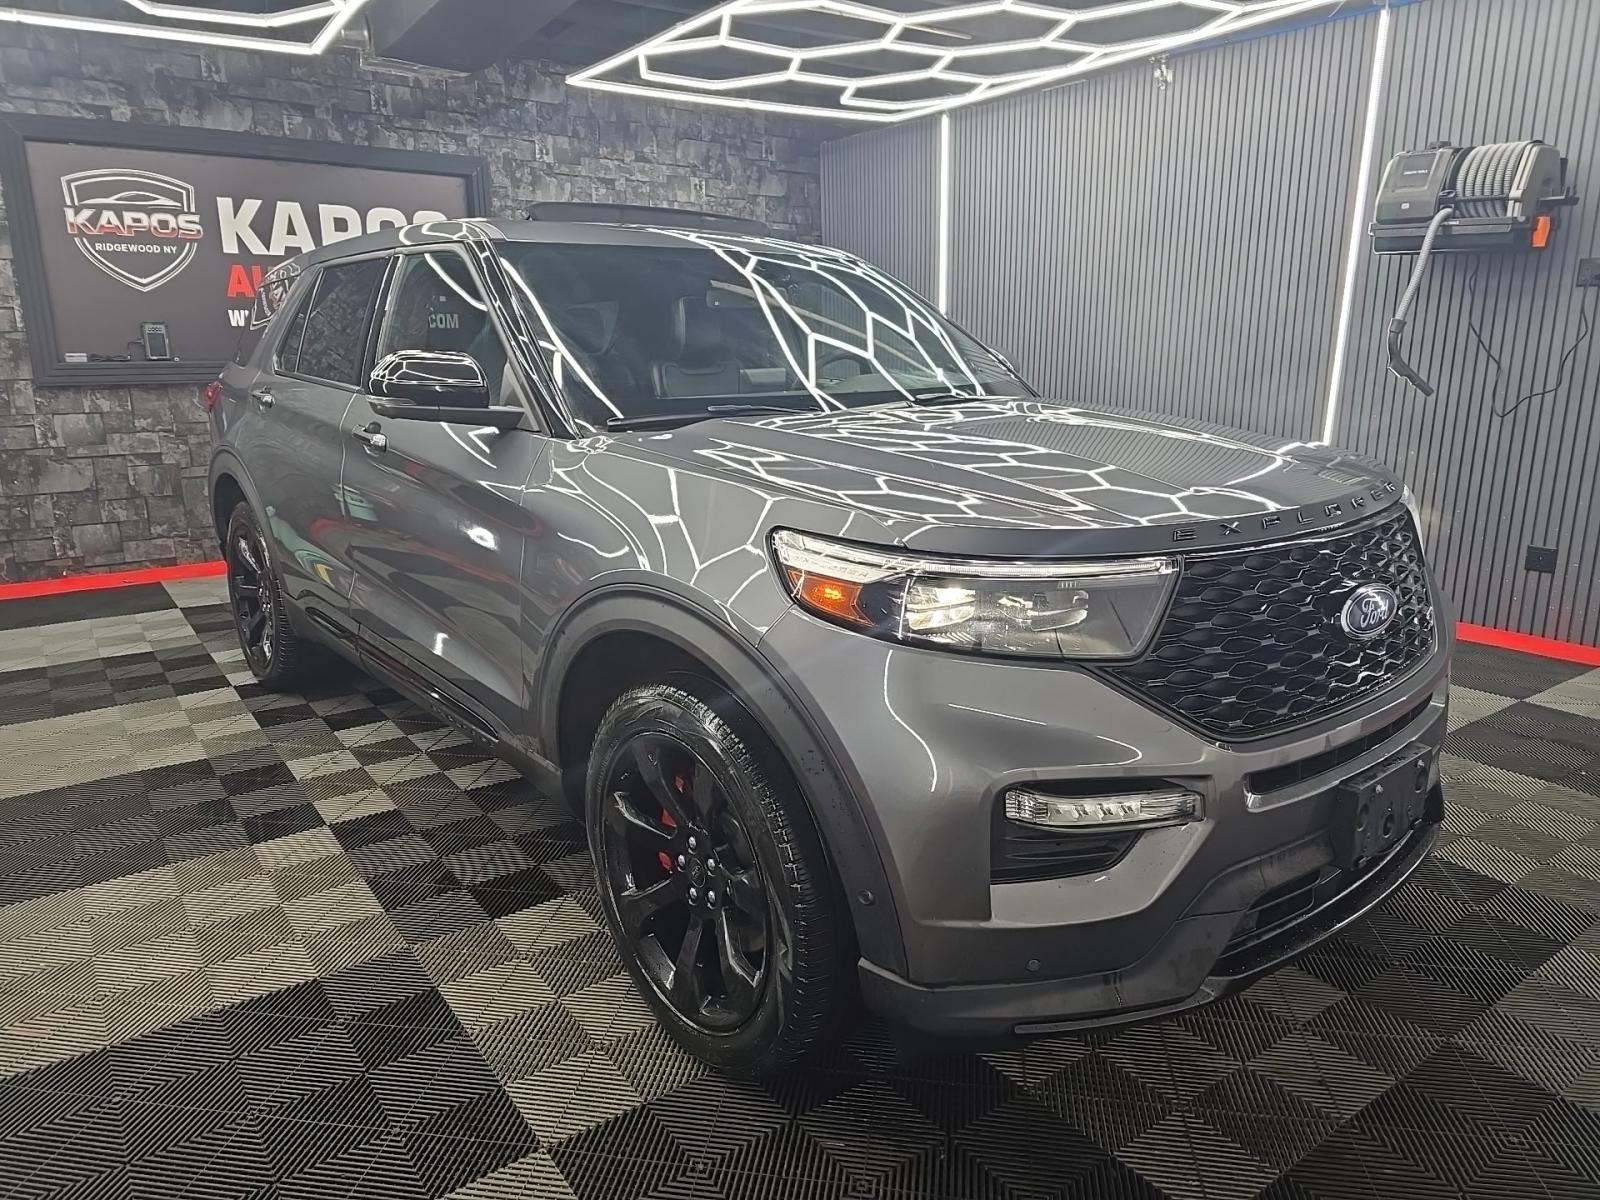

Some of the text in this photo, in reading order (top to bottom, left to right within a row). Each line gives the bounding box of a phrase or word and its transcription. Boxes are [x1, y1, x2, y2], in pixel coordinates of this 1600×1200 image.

[63, 207, 203, 239] KAPOS
[217, 197, 447, 256] KAP
[95, 243, 177, 254] RIDGEWOOD NY
[1173, 481, 1396, 542] EXPLORER
[1361, 595, 1389, 628] Ford
